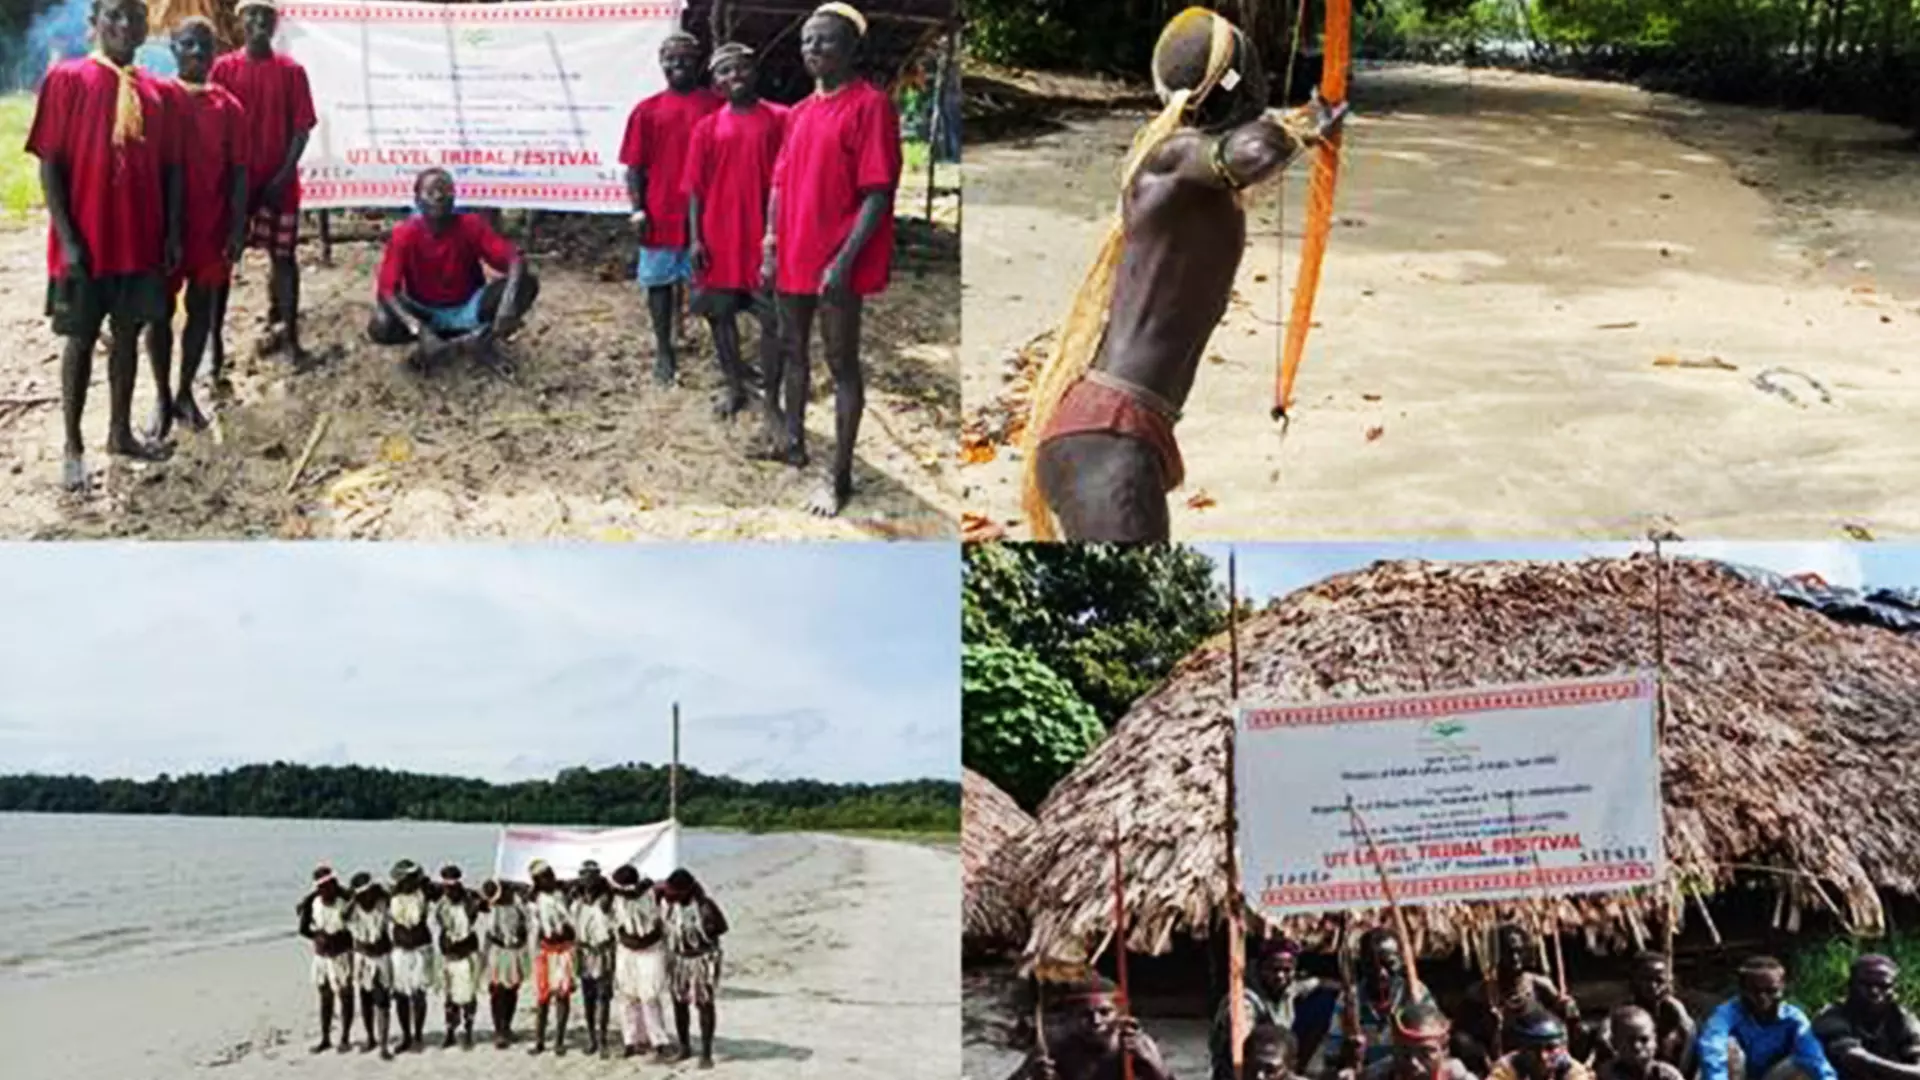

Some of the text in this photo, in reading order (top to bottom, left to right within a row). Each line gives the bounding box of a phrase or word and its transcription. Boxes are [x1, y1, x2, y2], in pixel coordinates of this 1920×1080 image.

[347, 149, 602, 167] UT LEVEL TRIBAL FESTIVAL
[1323, 851, 1349, 868] UT
[1418, 841, 1486, 860] TRIBAL
[1492, 833, 1582, 853] FESTIVAL
